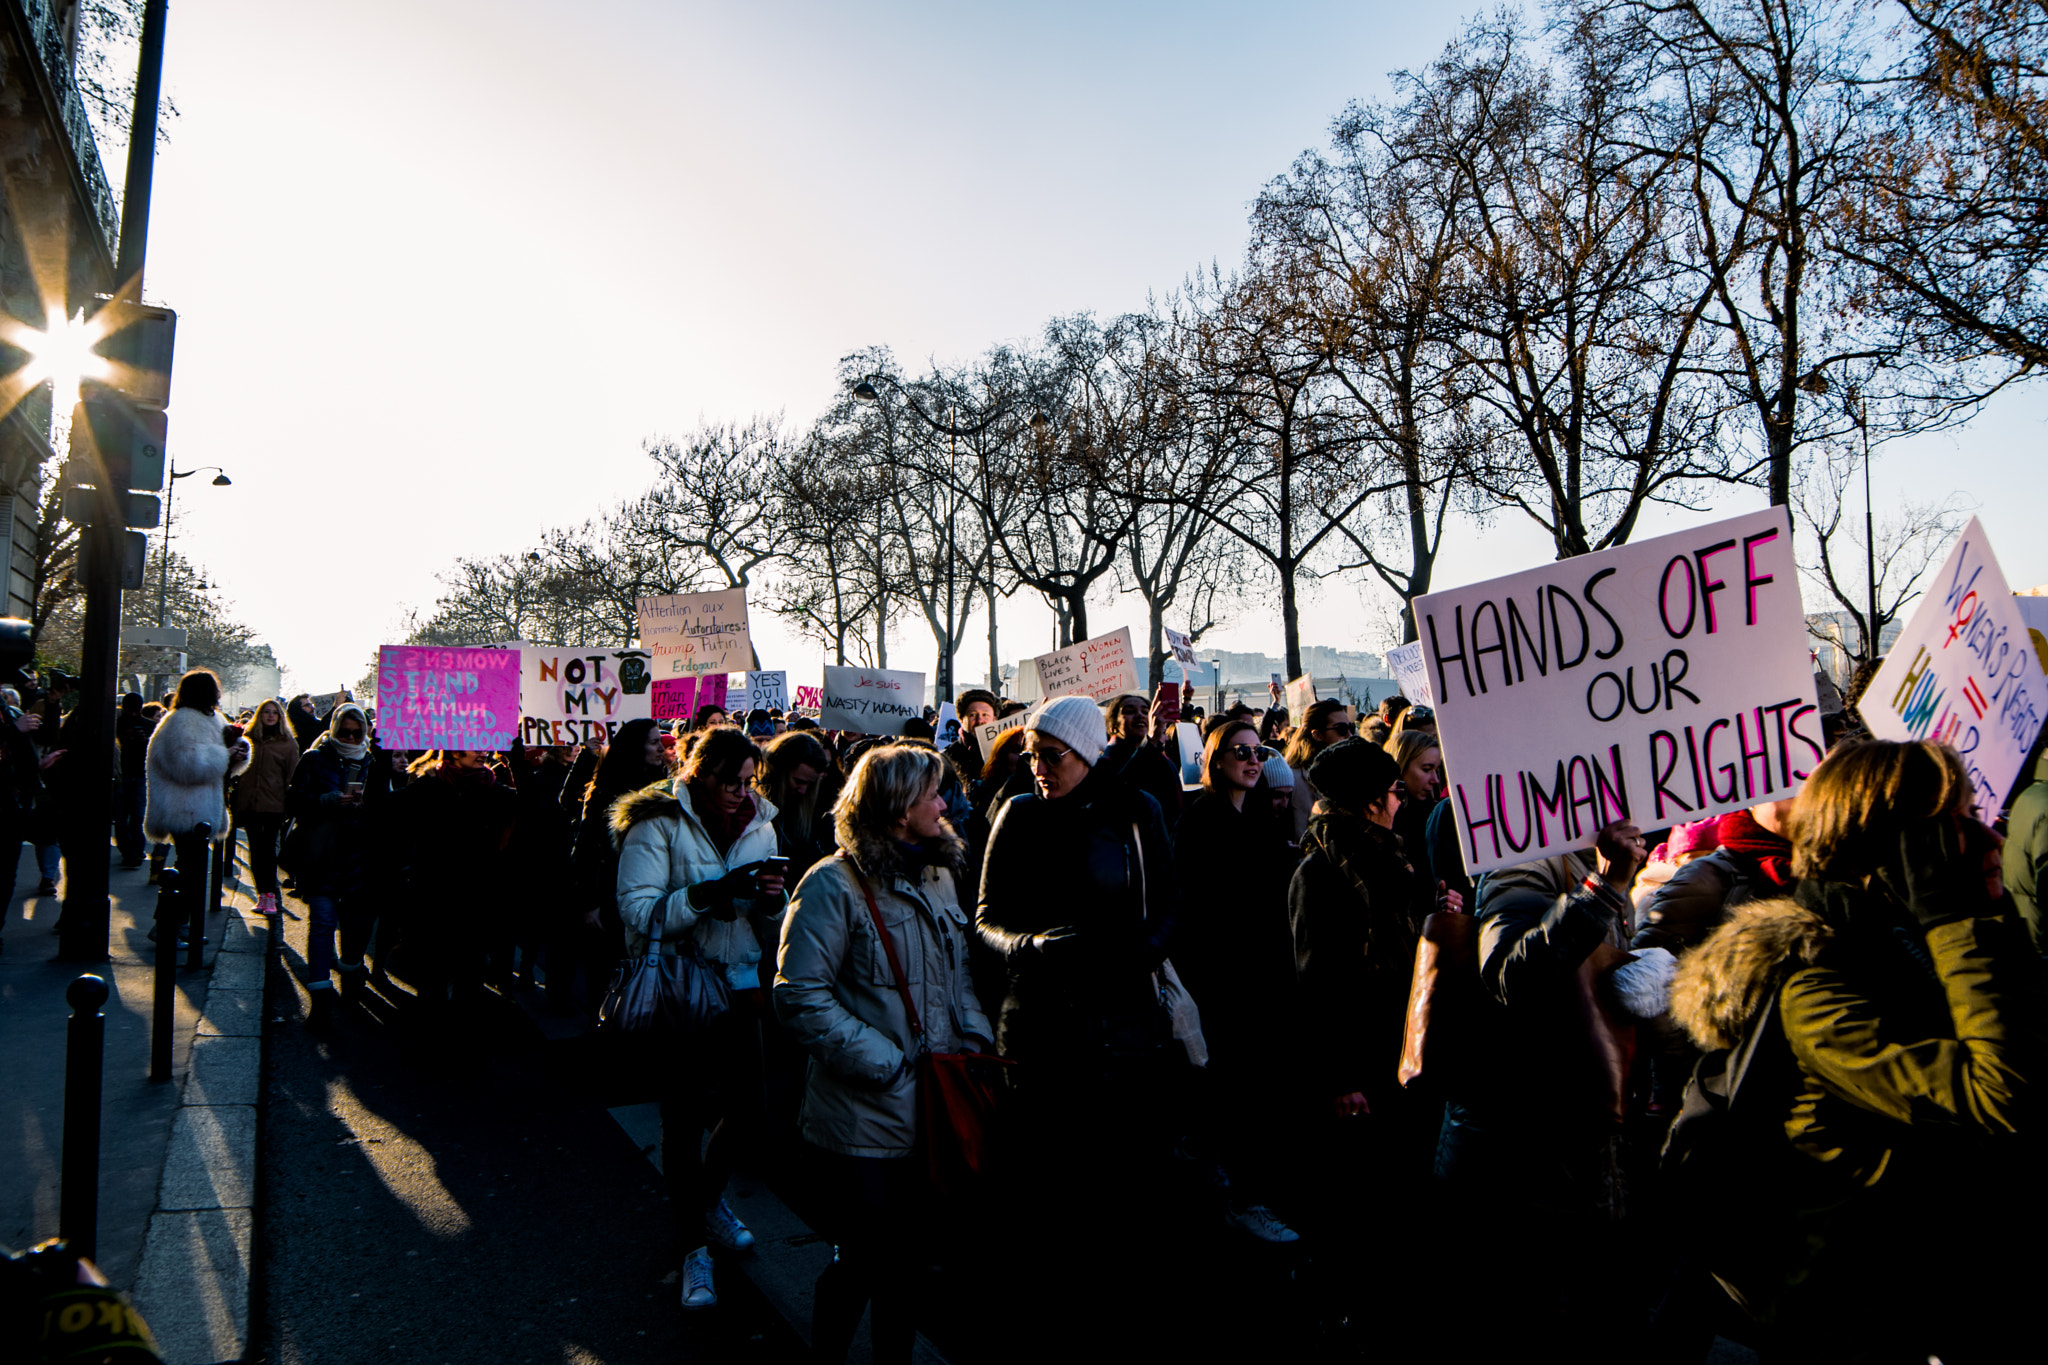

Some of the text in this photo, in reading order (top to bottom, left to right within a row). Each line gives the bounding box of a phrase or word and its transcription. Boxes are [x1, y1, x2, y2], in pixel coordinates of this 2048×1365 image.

[637, 596, 725, 619] Attention aux
[1426, 526, 1779, 704] HANDS OFF
[643, 622, 679, 636] hommes
[381, 650, 399, 668] I
[1039, 654, 1073, 671] BLACK
[1096, 658, 1127, 675] MATTER
[540, 655, 606, 684] NOT
[1044, 665, 1071, 679] LIVES
[379, 669, 479, 695] STAND
[652, 681, 672, 689] are
[749, 673, 781, 689] YES
[853, 675, 902, 691] Je suis
[1049, 674, 1083, 691] MATTER
[1586, 648, 1702, 723] OUR
[564, 686, 618, 715] MY
[752, 687, 779, 700] OUI
[753, 697, 784, 711] CAN
[826, 696, 871, 715] NASTY
[872, 701, 919, 718] WOMAN
[380, 706, 497, 730] PLANNED
[378, 727, 515, 750] PARENTHOOD
[523, 716, 627, 747] PRESIDE
[1456, 743, 1632, 865] HUMAN
[1649, 697, 1824, 820] RIGHTS
